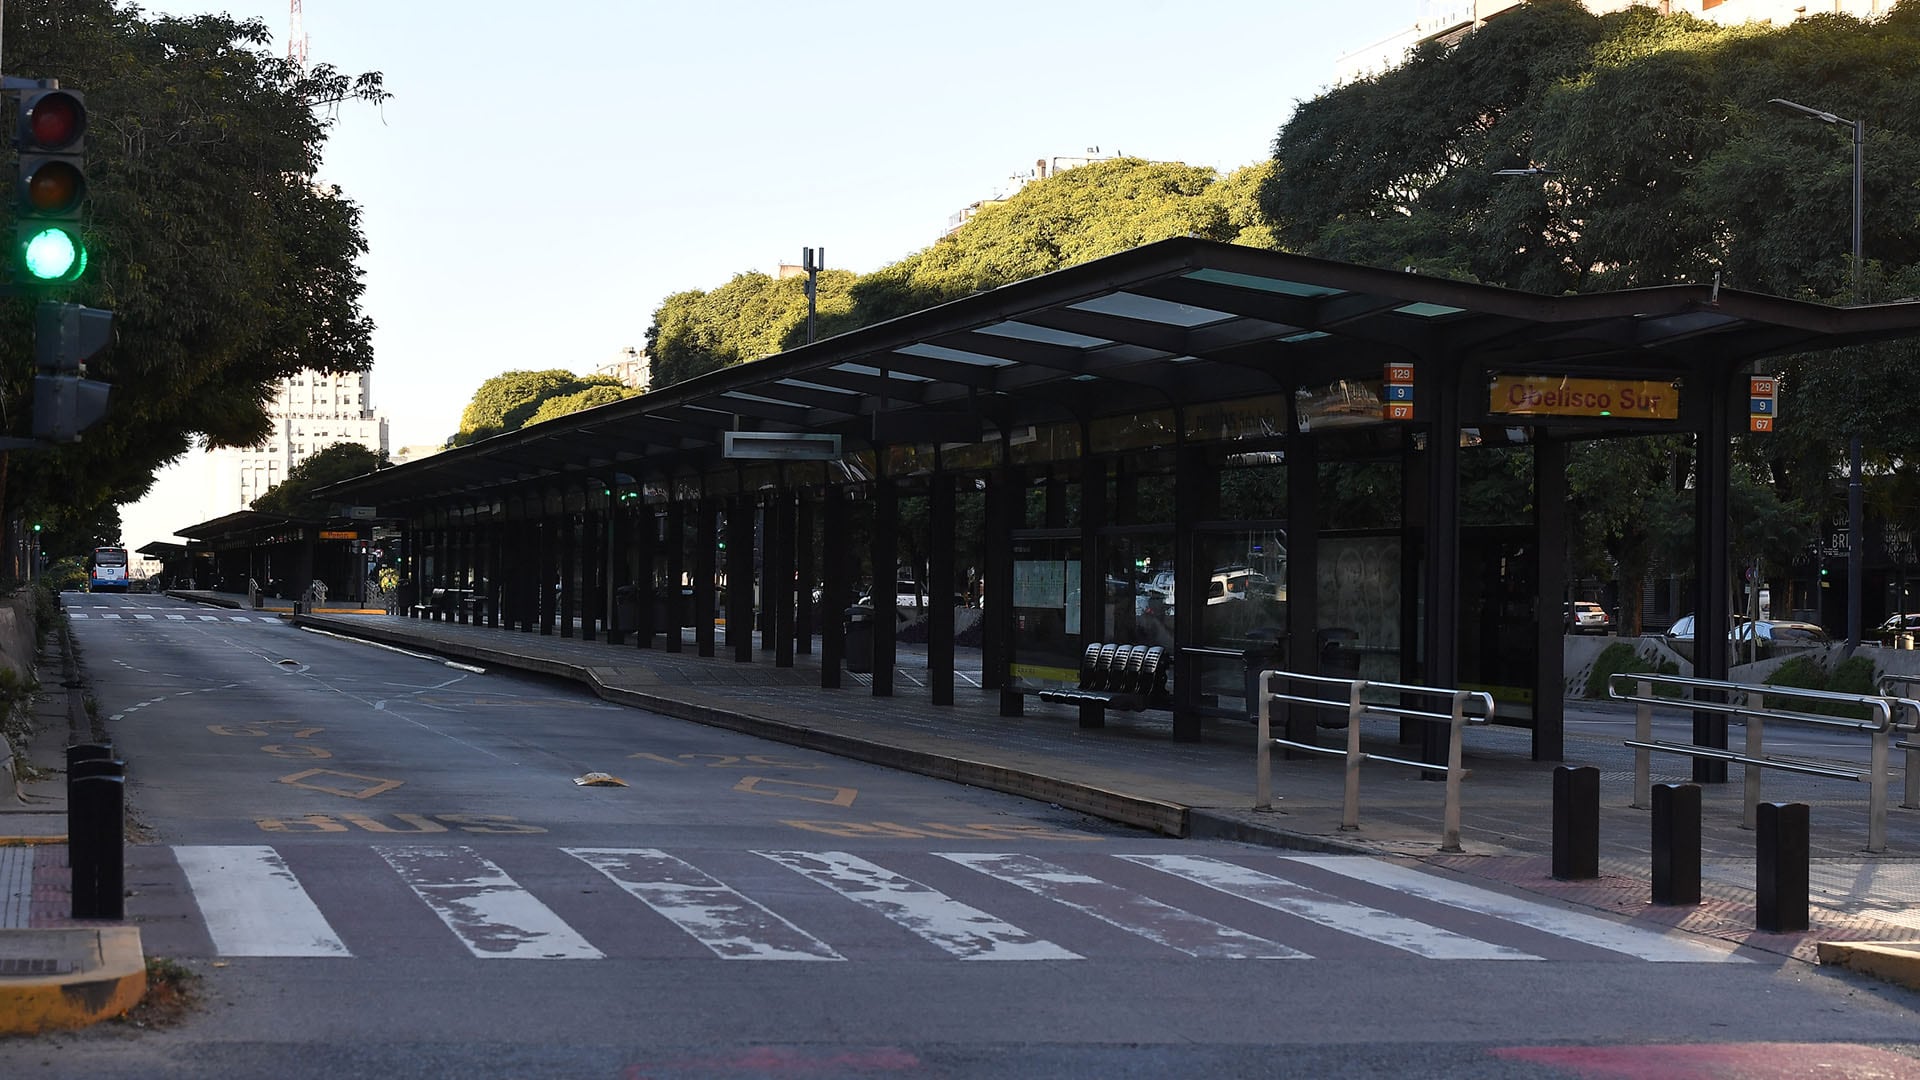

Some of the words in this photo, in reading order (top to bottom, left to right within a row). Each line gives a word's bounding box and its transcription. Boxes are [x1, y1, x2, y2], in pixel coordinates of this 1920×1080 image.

[1392, 369, 1410, 379] 129
[1754, 382, 1770, 392] 129
[1397, 388, 1405, 398] 9
[1509, 383, 1611, 409] Obelisco
[1619, 388, 1662, 411] Sur
[1759, 401, 1766, 411] 9
[1394, 407, 1408, 417] 67
[1756, 420, 1769, 429] 67
[1832, 533, 1849, 549] BRI
[253, 813, 549, 834] BUS
